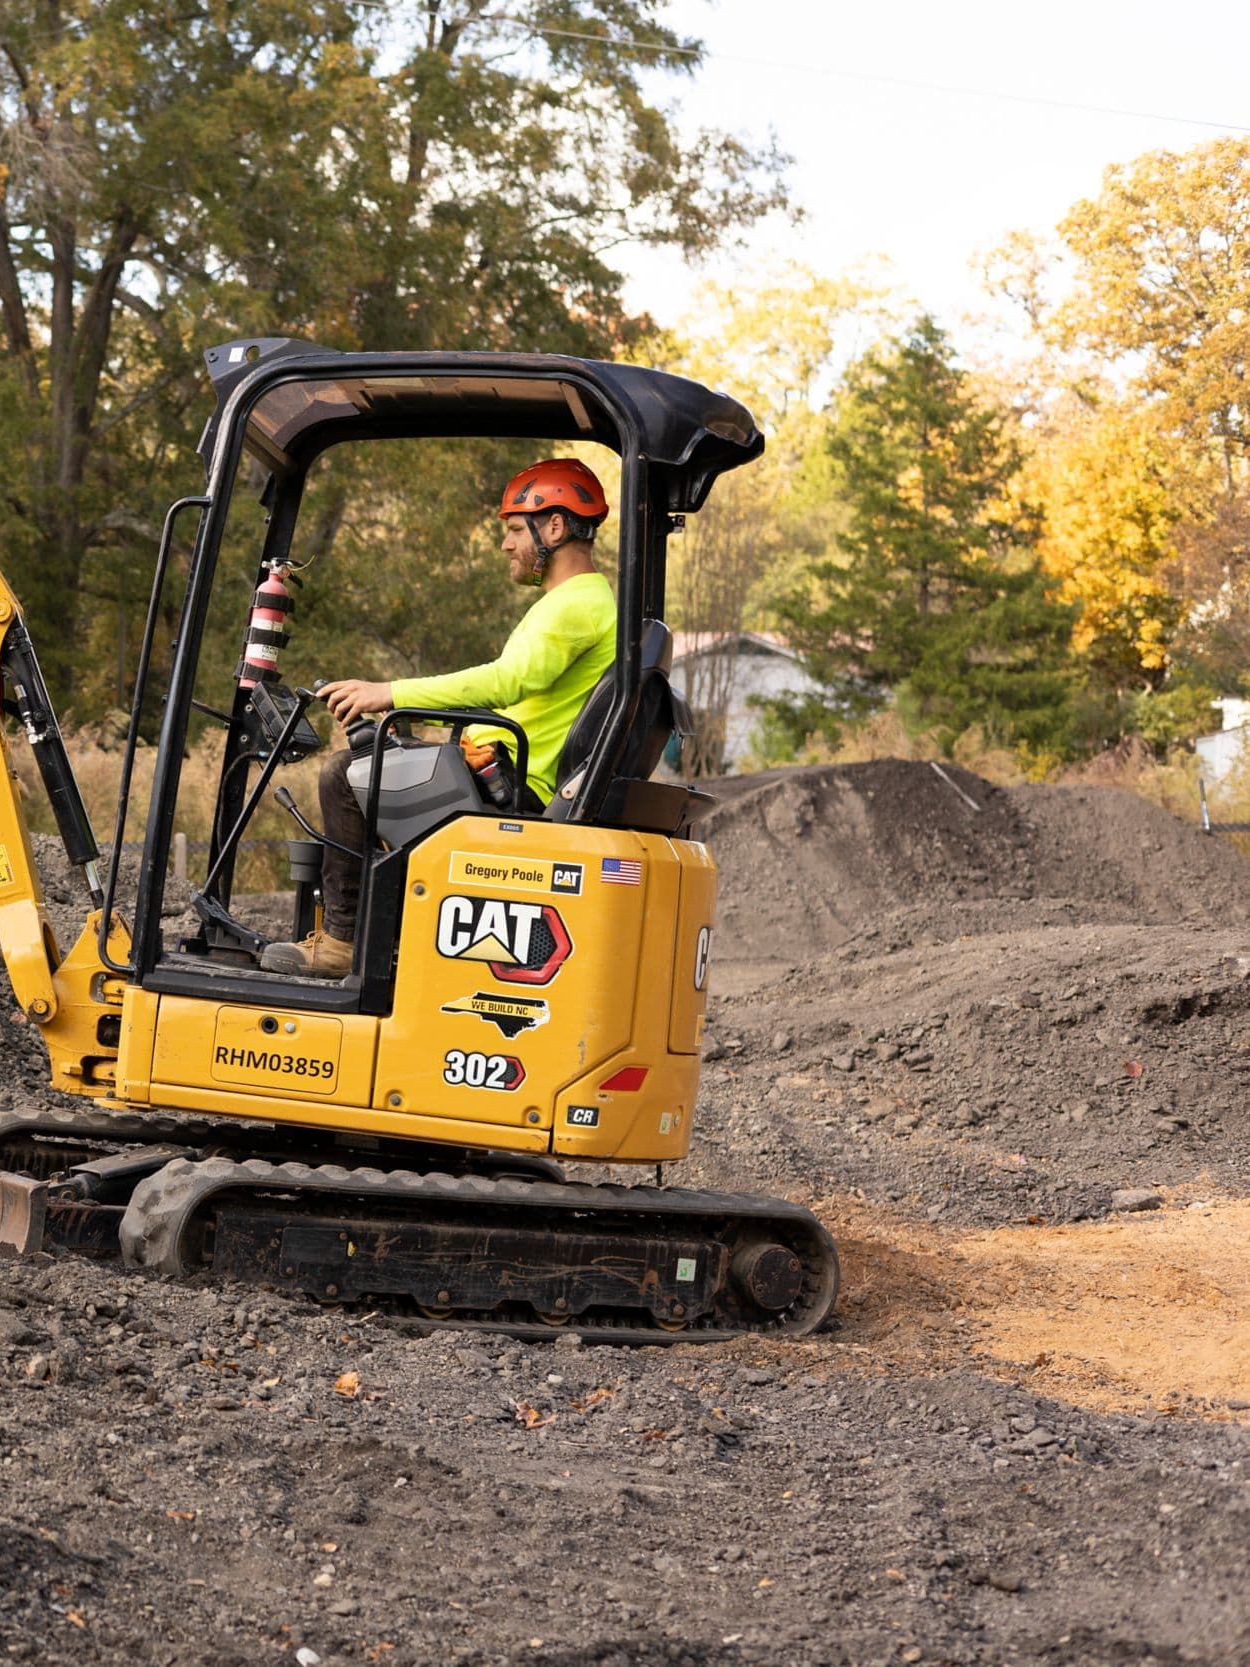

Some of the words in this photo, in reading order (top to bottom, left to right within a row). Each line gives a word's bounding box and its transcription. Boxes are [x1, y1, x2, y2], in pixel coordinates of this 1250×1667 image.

[465, 862, 509, 881] Gregory
[511, 867, 544, 882] Poole
[554, 869, 580, 886] CAT
[438, 896, 542, 965] CAT
[471, 1001, 486, 1011] WE
[488, 1003, 514, 1014] BUILD
[516, 1006, 528, 1016] NC
[214, 1046, 334, 1079] RHM03859
[445, 1050, 509, 1088] 302
[572, 1110, 594, 1124] CR
